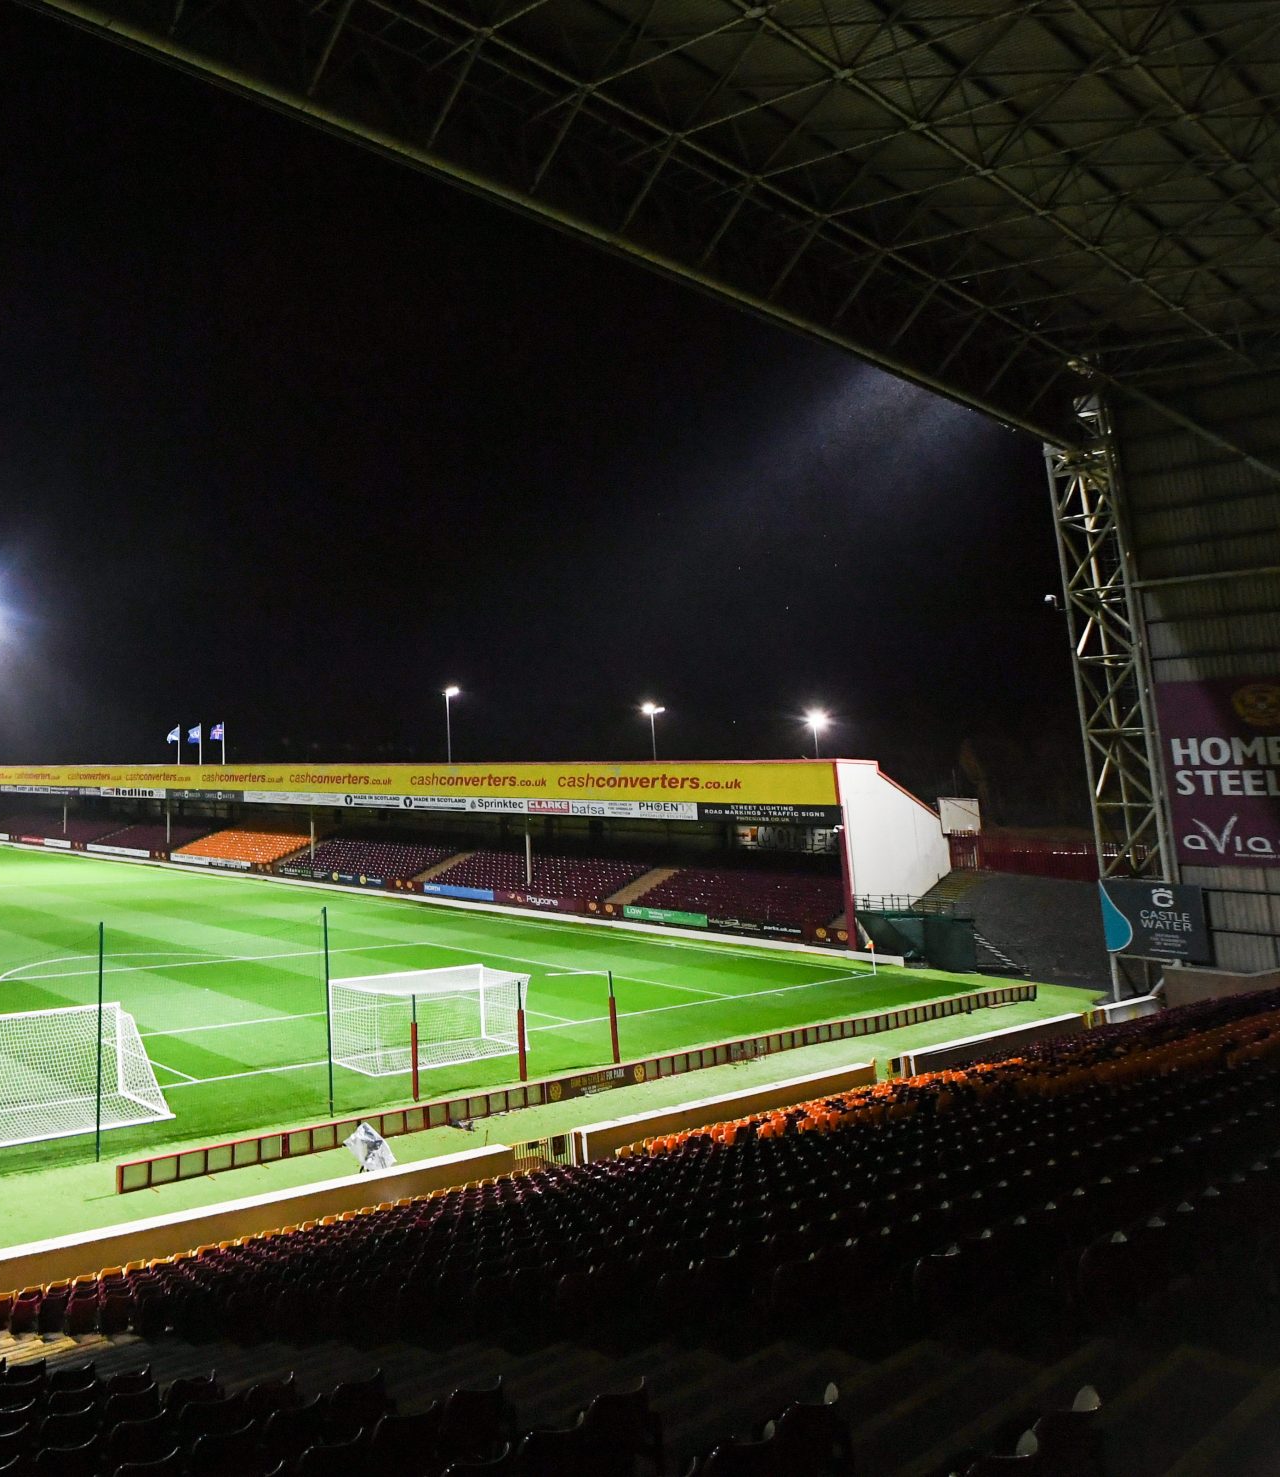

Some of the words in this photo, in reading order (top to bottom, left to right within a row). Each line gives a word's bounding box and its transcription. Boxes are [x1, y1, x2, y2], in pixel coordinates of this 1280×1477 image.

[1170, 736, 1280, 766] HOME
[201, 772, 284, 784] cashconverters.co.uk
[289, 771, 392, 786] cashconverters.co.uk
[410, 773, 547, 788] cashconverters.co.uk
[557, 773, 742, 790] cashconverters.co.uk
[115, 787, 154, 797] Redline
[477, 799, 524, 810] Sprinktec
[528, 801, 569, 810] CLARKE
[571, 803, 605, 815] bafsa
[638, 802, 693, 813] PHOENIX
[424, 884, 441, 892] NORTH
[526, 894, 559, 906] Paycare
[1139, 909, 1190, 923] CASTLE
[1141, 919, 1193, 932] WATER
[613, 1068, 624, 1079] PARK
